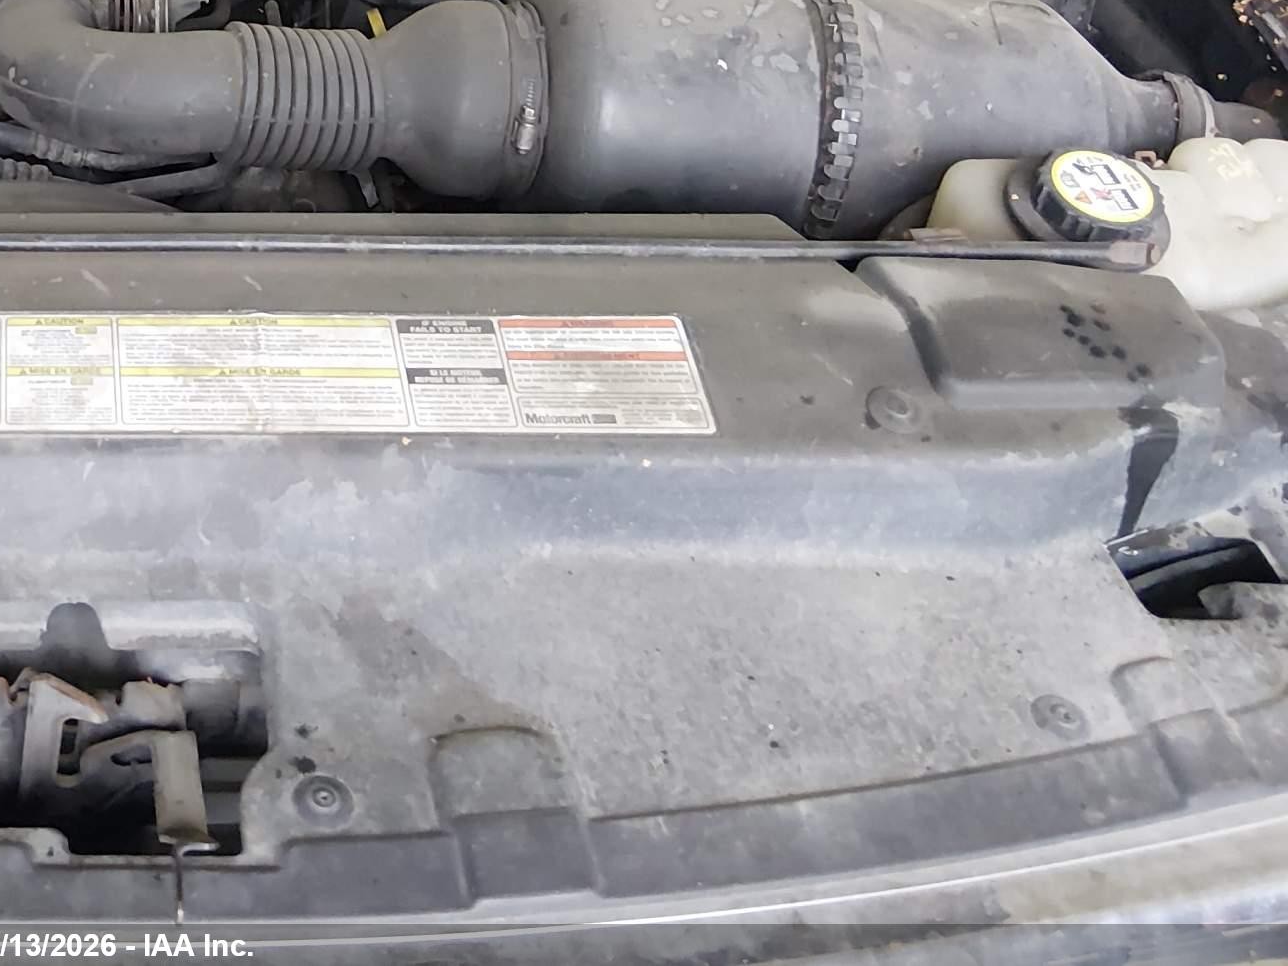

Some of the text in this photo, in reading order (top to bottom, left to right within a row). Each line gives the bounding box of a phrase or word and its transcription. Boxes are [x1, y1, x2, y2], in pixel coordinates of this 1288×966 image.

[439, 326, 452, 334] TO
[453, 326, 483, 334] START
[525, 413, 592, 424] Motorcraft
